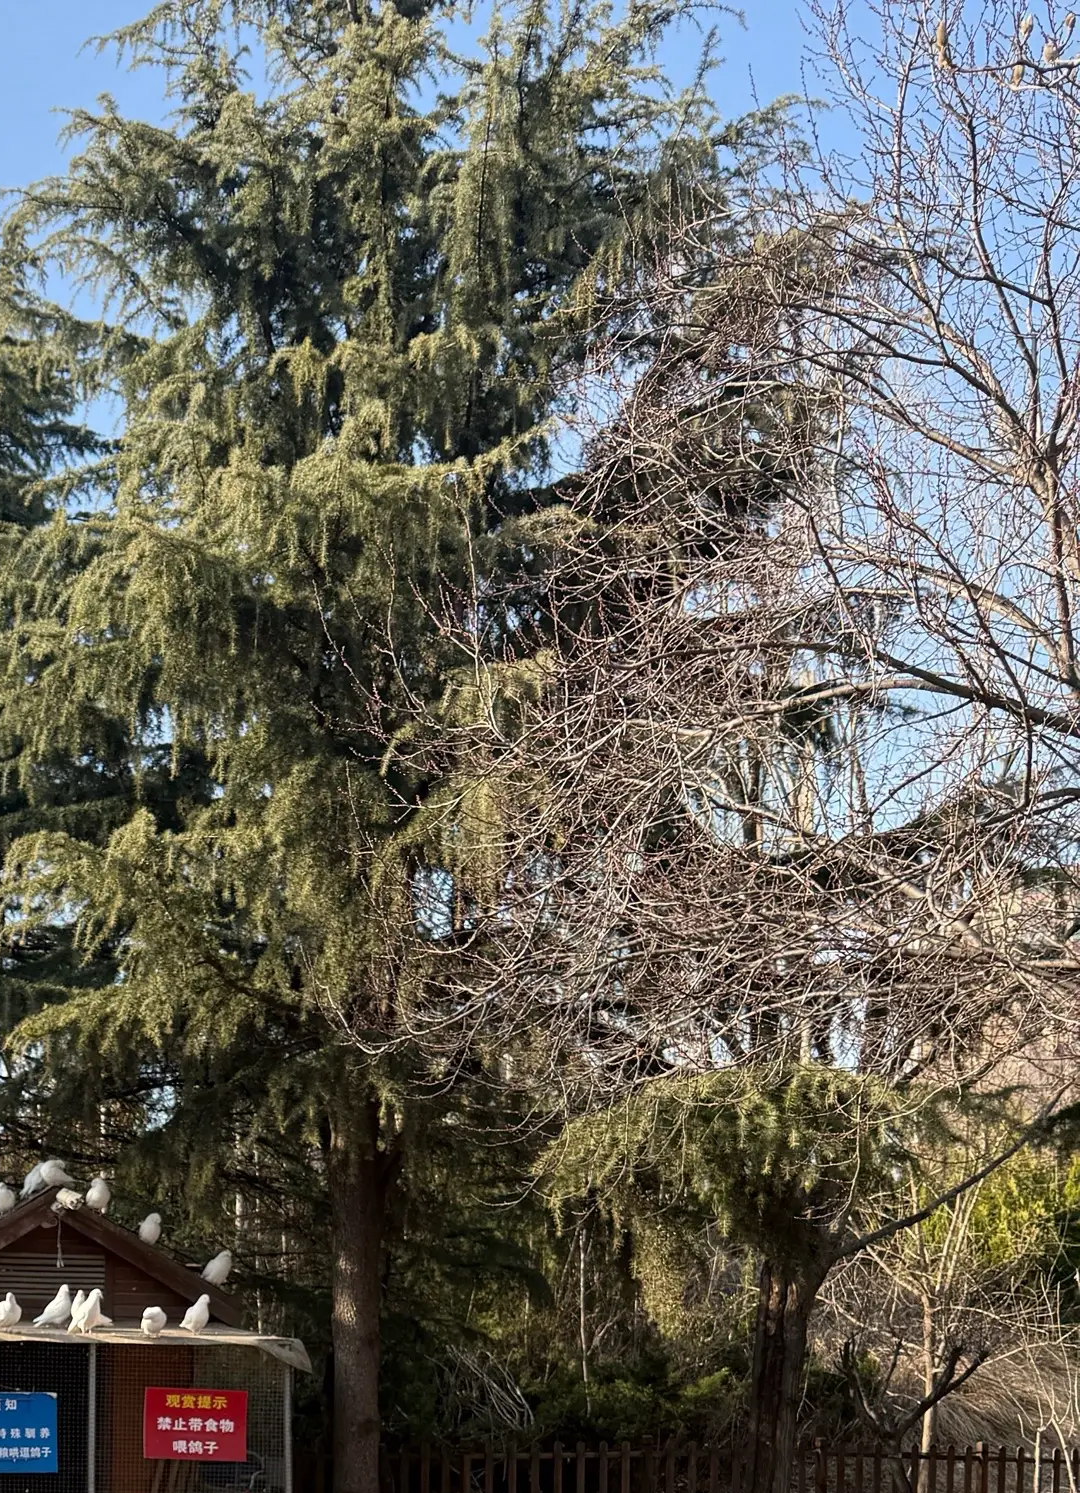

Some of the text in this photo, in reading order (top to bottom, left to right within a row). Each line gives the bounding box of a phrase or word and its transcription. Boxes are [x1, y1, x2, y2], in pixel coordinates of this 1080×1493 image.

[166, 1394, 228, 1409] 观赏提示
[157, 1416, 235, 1433] 禁止带食物
[172, 1440, 219, 1454] 喂鸽子
